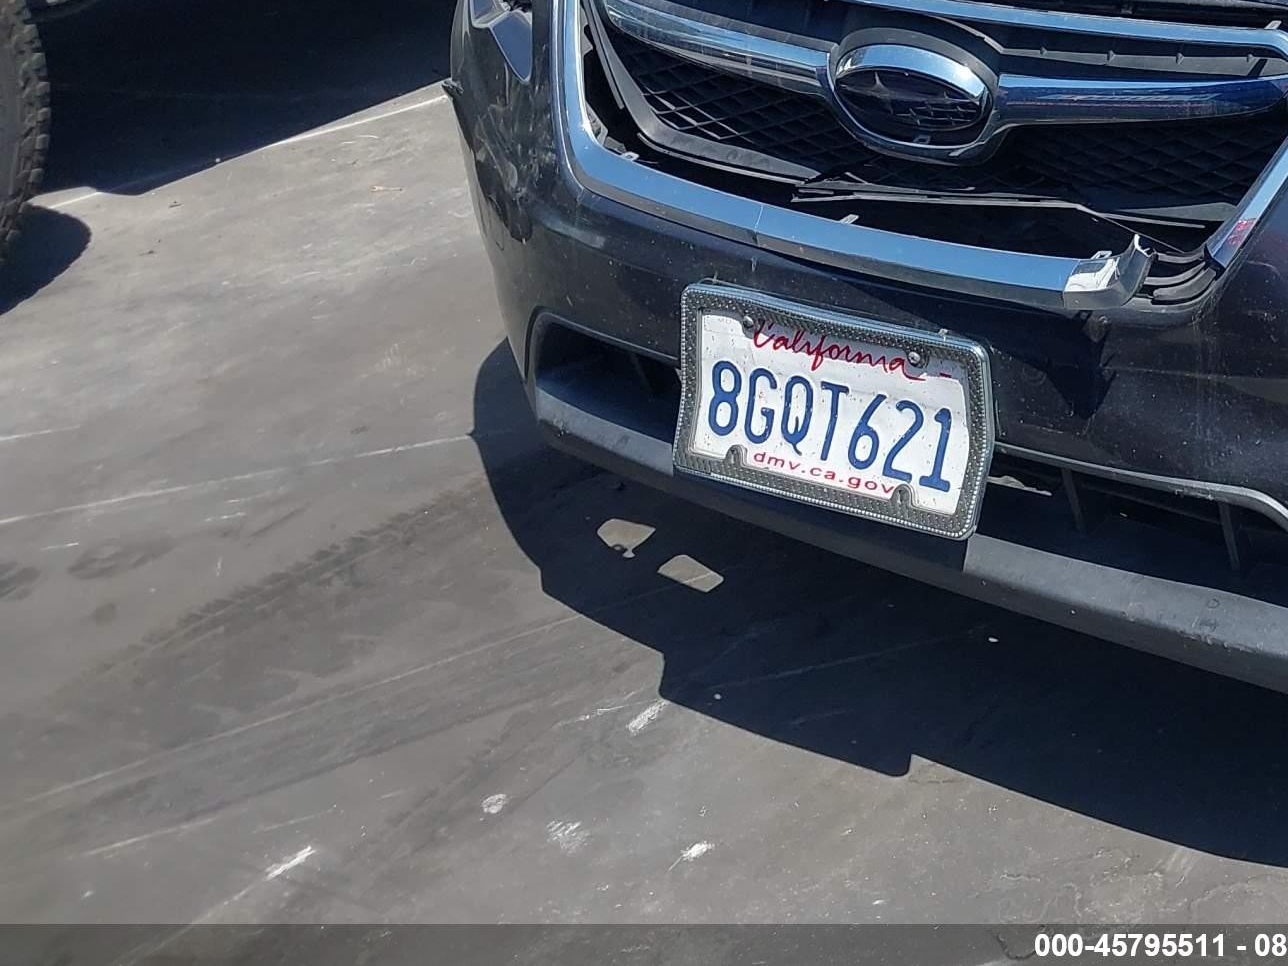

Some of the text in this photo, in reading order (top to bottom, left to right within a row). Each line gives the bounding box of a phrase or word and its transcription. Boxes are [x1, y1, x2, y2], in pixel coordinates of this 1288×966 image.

[752, 321, 925, 381] California
[707, 360, 953, 493] 8GQT621
[753, 451, 895, 495] dmv.ca.gov
